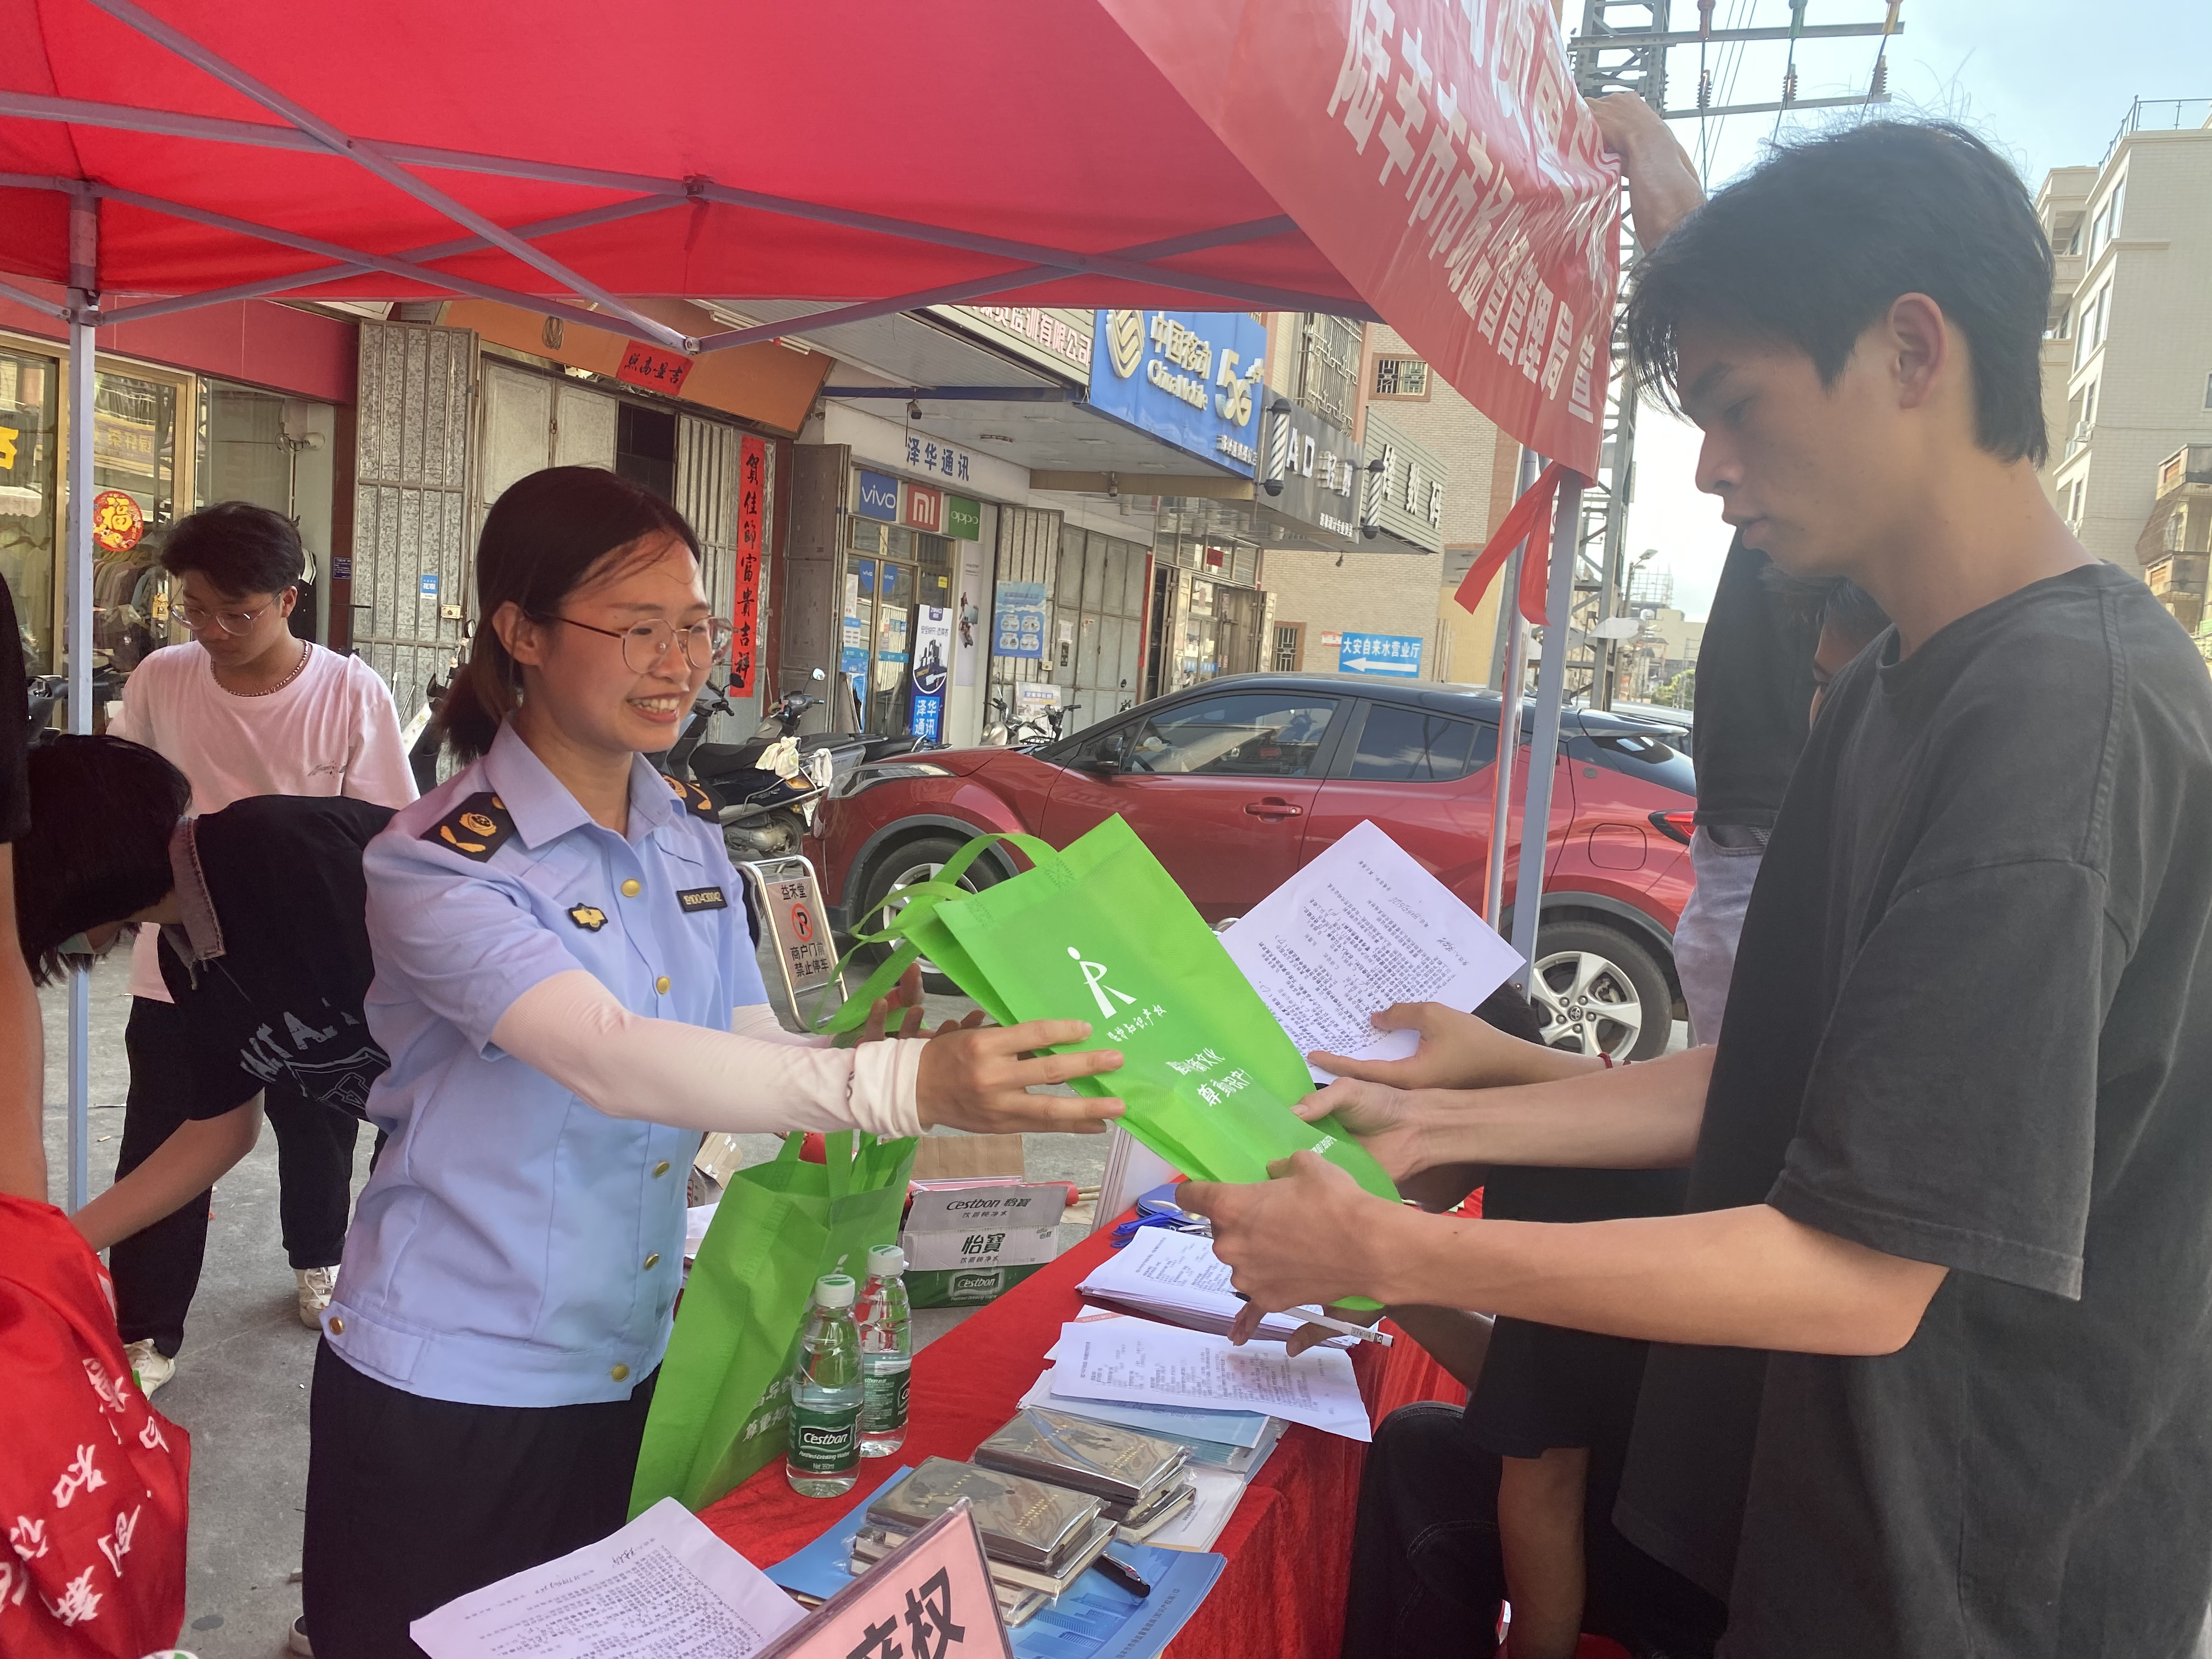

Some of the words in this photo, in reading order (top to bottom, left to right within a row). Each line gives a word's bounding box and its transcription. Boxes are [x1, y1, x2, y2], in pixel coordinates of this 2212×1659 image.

[1150, 312, 1212, 379] 中国移动
[906, 437, 969, 481] 泽华通讯
[861, 484, 896, 509] vivo
[951, 511, 979, 526] oppo
[1342, 637, 1420, 659] 大安自来水营业厅
[917, 699, 937, 716] 泽华
[915, 718, 935, 735] 通讯
[781, 883, 807, 900] 益禾堂
[790, 941, 825, 961] 商户门前
[795, 958, 829, 977] 禁止停车
[961, 1233, 1006, 1255] 怡寶
